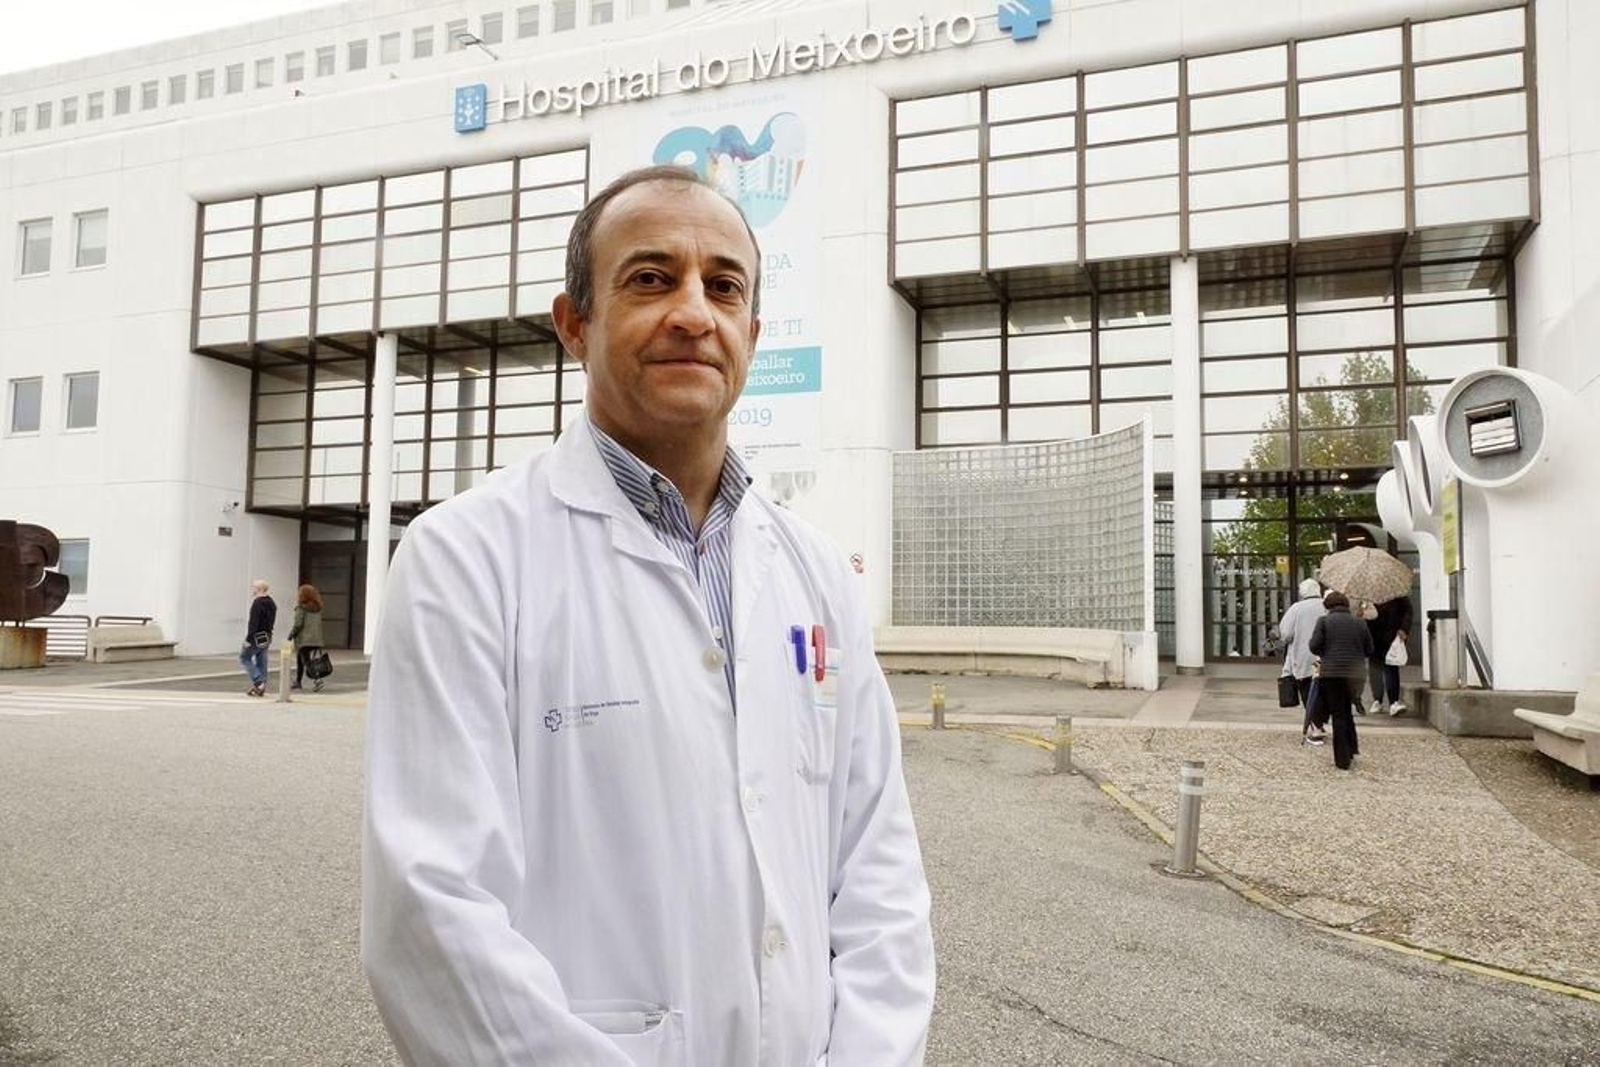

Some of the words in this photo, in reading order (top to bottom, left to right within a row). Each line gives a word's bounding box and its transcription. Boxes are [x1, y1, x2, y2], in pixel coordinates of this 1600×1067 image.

[498, 57, 662, 119] Hospital
[676, 49, 730, 89] do
[749, 12, 976, 79] Meixoeiro
[727, 409, 773, 427] 2019
